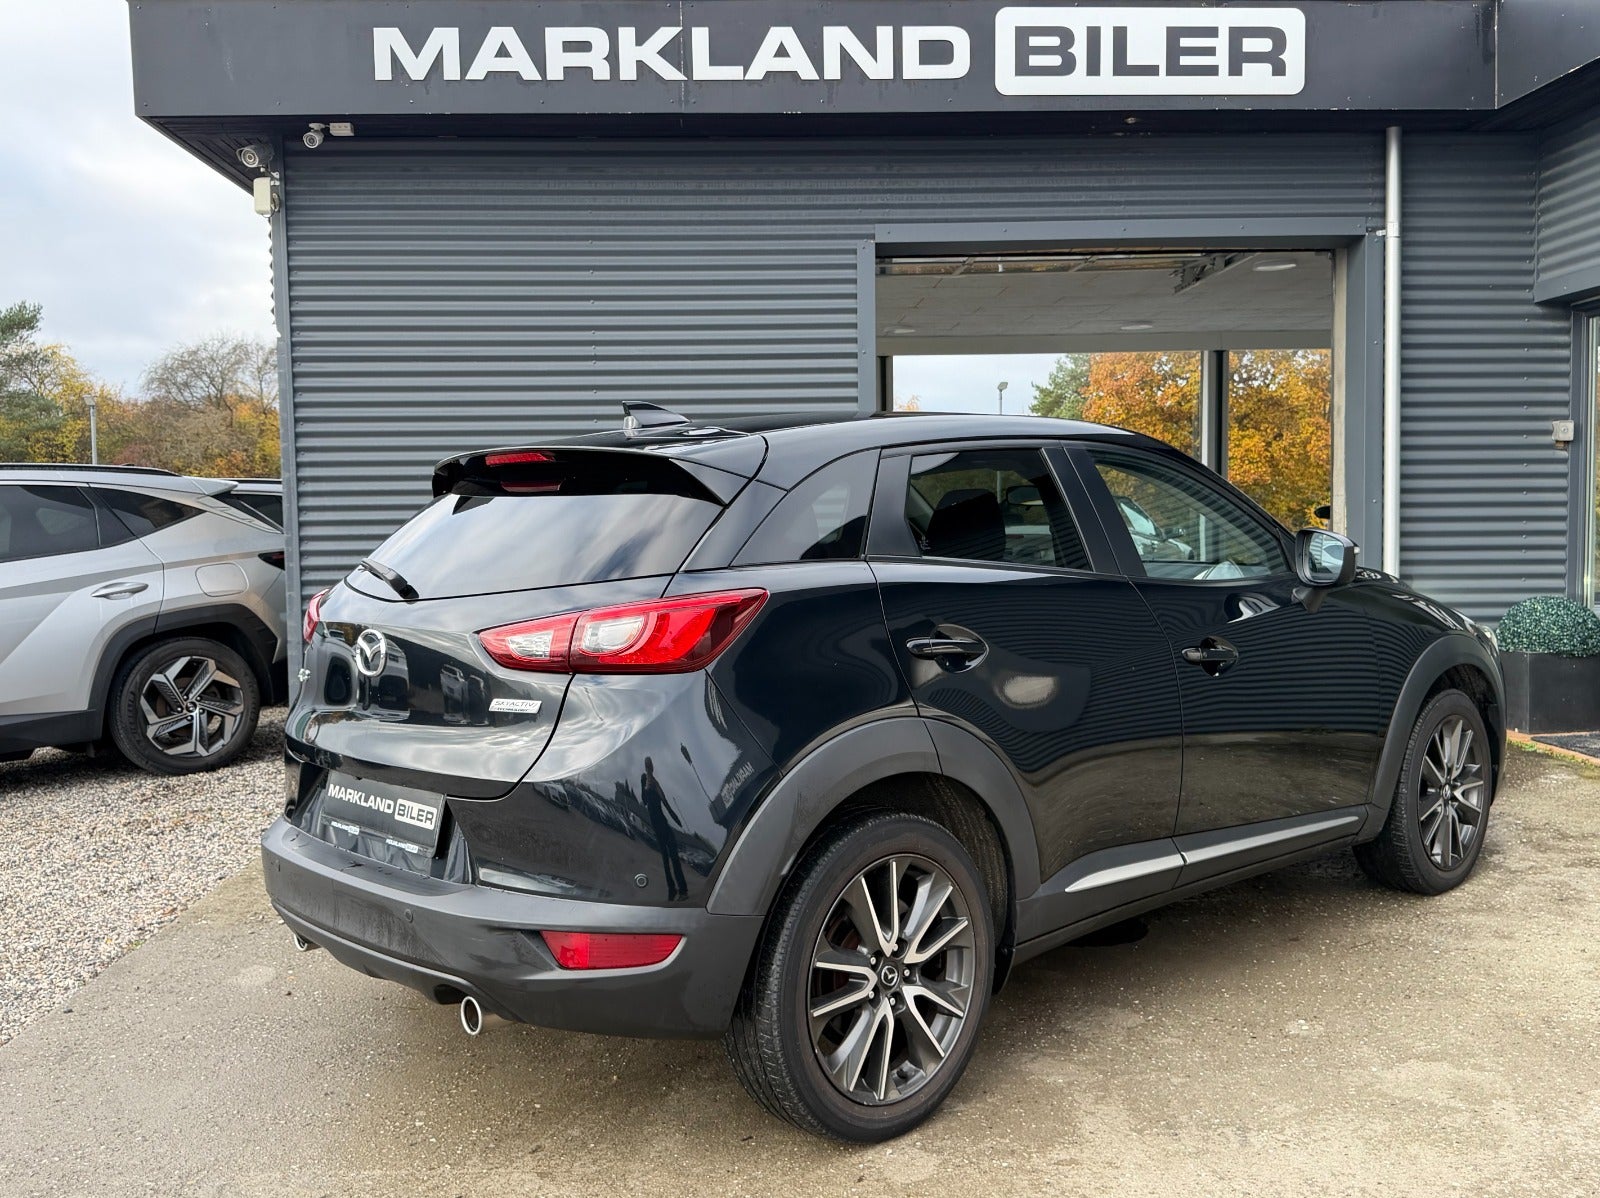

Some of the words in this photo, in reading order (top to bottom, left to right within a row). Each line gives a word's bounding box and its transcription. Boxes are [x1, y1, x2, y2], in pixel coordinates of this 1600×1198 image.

[373, 26, 971, 81] MARKLAND
[1014, 25, 1288, 77] BILER
[328, 783, 394, 814] MARKLAND
[397, 803, 435, 825] BILER
